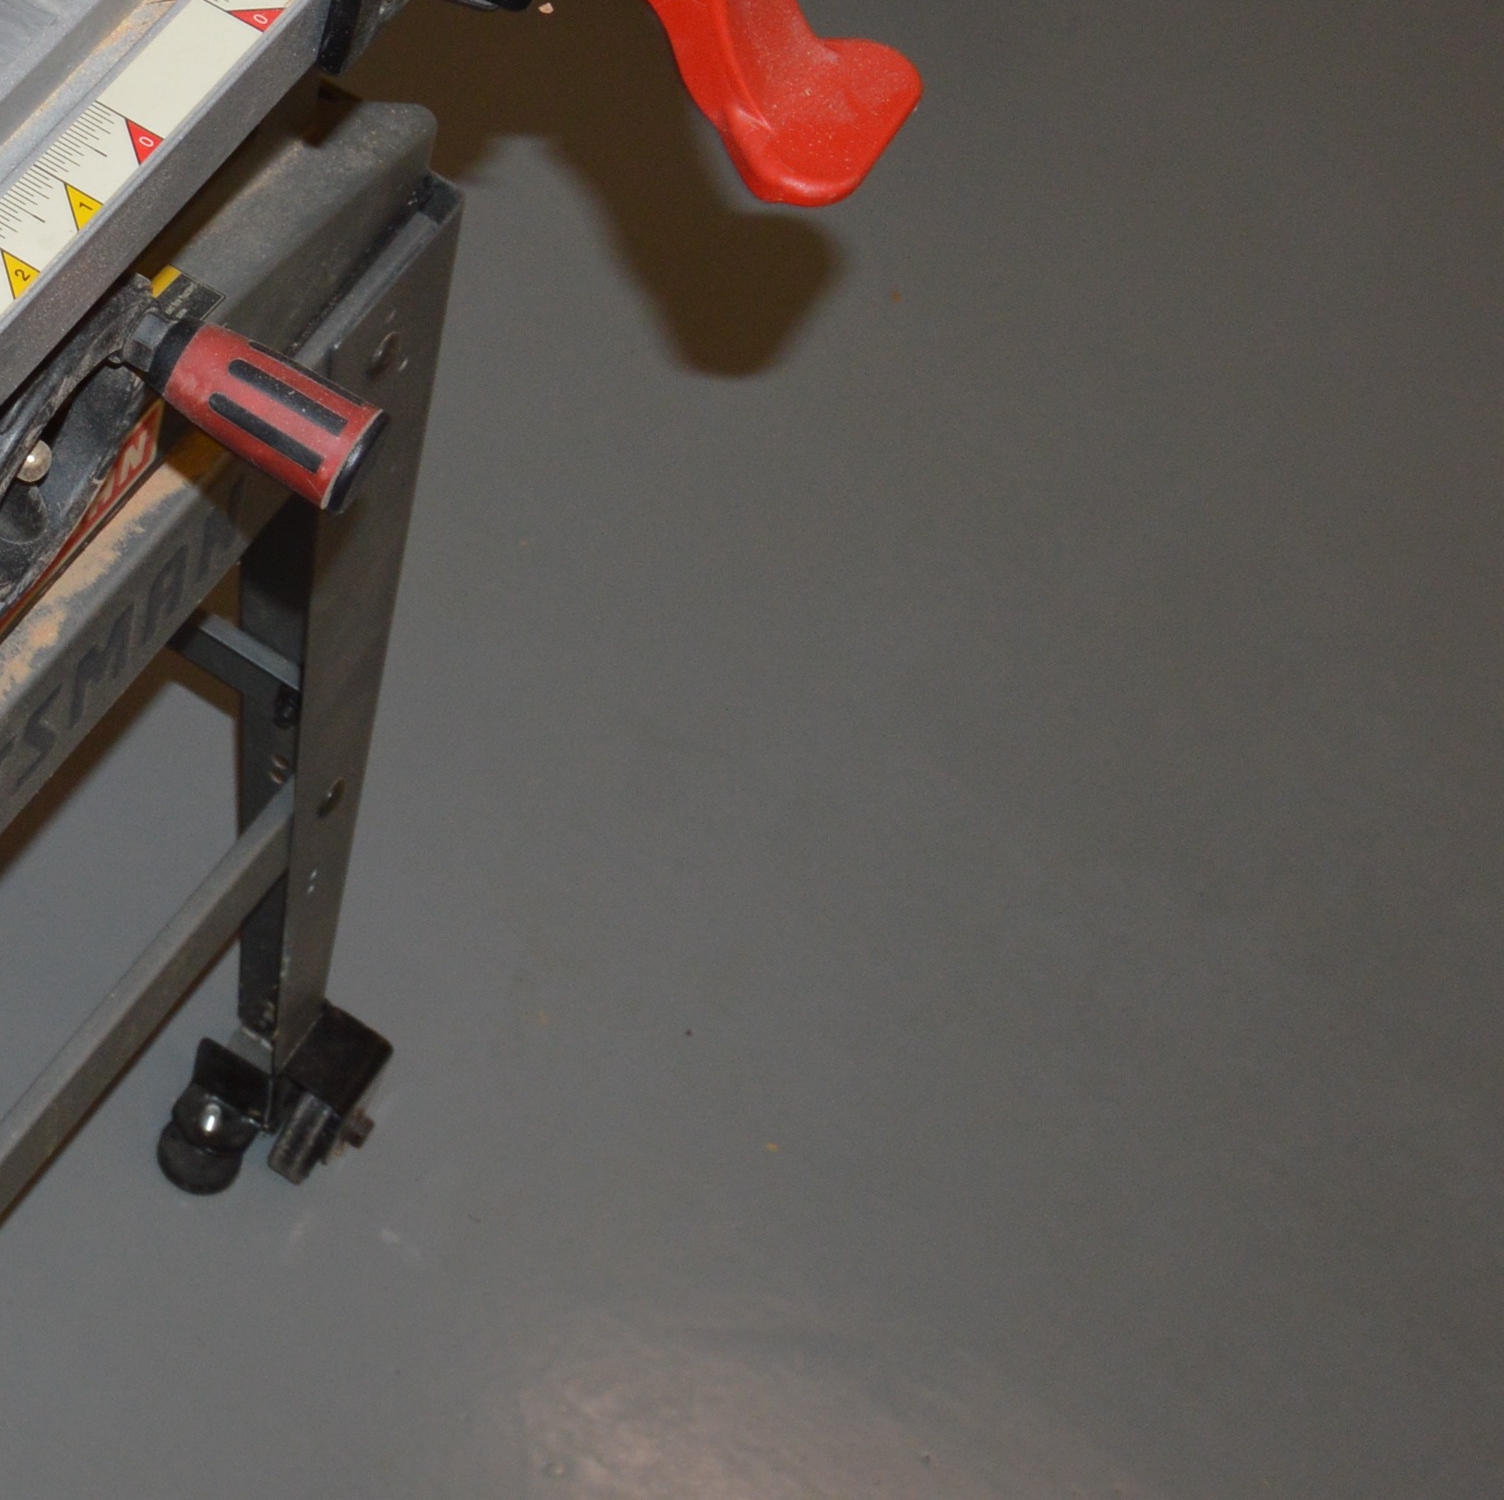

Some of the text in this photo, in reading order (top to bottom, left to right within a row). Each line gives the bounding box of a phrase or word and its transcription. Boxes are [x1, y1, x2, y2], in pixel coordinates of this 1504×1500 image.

[252, 12, 269, 27] 0
[138, 133, 155, 150] 0
[79, 199, 94, 213] 1
[14, 267, 31, 284] 2
